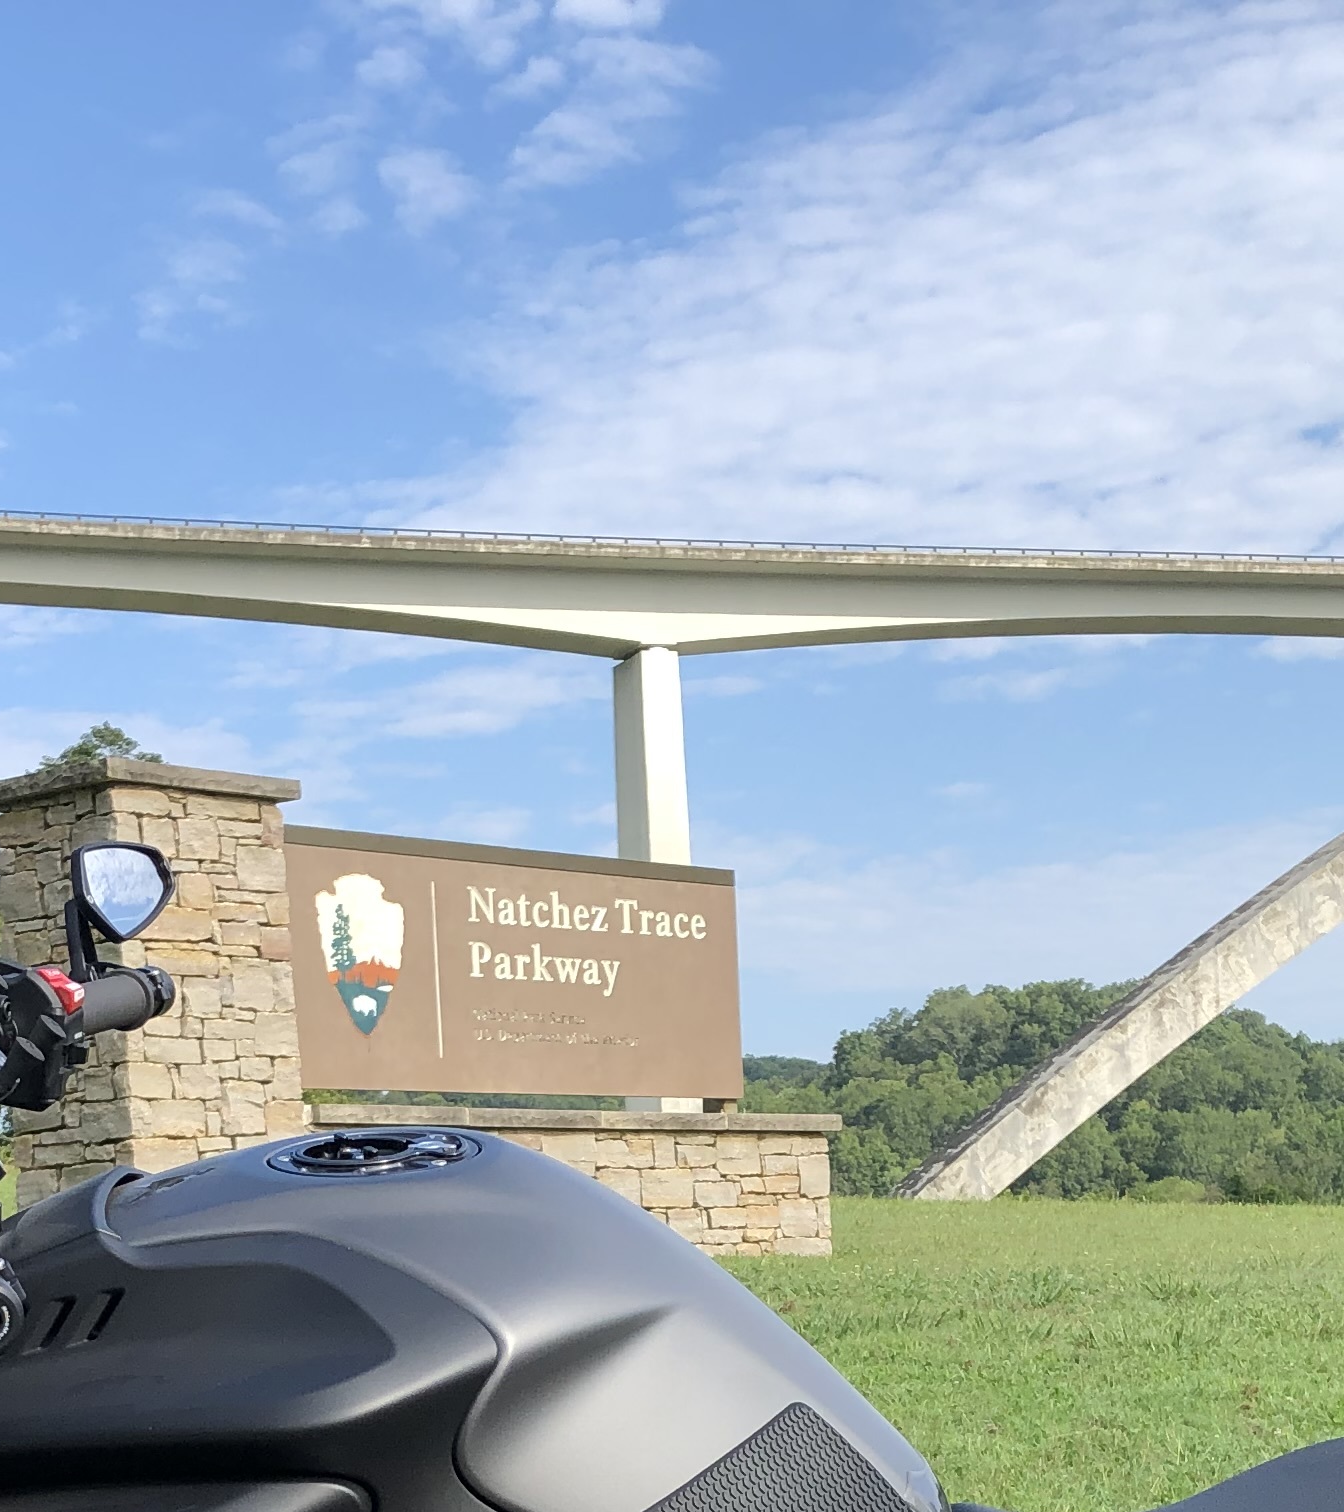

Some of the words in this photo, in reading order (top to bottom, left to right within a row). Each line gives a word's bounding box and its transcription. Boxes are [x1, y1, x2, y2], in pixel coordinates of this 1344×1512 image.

[467, 885, 609, 932] Natchez
[614, 898, 707, 940] Trace
[468, 941, 621, 996] Parkway
